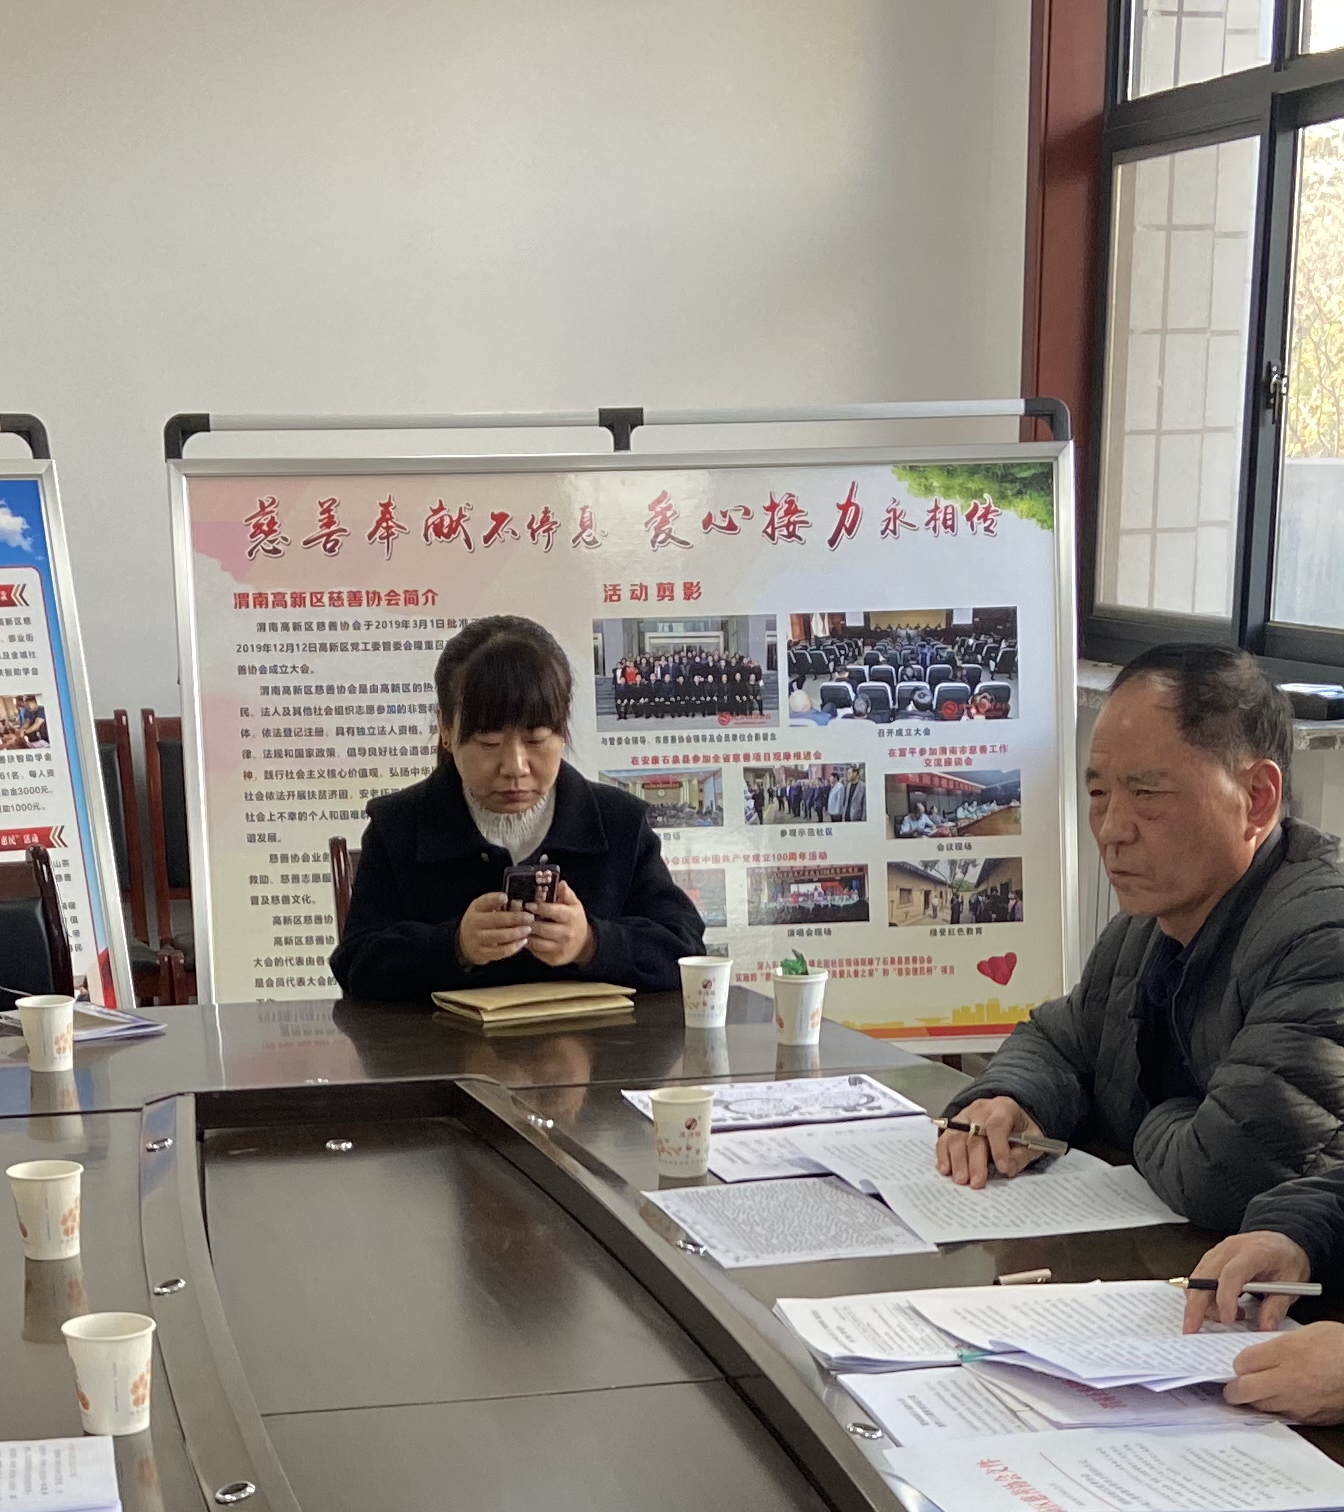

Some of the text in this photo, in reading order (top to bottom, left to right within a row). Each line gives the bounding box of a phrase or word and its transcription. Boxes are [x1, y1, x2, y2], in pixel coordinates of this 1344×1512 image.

[242, 479, 1003, 560] 慈善奉献不停息 爱心接力永相传
[603, 581, 702, 602] 活动剪影
[233, 588, 439, 609] 渭南高新区慈善协会简介
[236, 639, 446, 653] 2019年12月12日高新区党工委管委会隆重召
[237, 663, 315, 675] 善协会成立大会。
[877, 727, 931, 738] 召开成立大会
[888, 744, 1009, 758] 在富平参加渭南市慈善工作
[923, 756, 973, 768] 交流座谈会
[780, 827, 833, 838] 参观示范社区
[936, 842, 973, 852] 会议现场
[272, 915, 334, 926] 高新区慈善协
[787, 927, 832, 937] 演唱会现场
[929, 926, 984, 937] 接受红色教育
[273, 936, 335, 947] 高新区慈善协
[253, 956, 331, 968] 大会的代表由各
